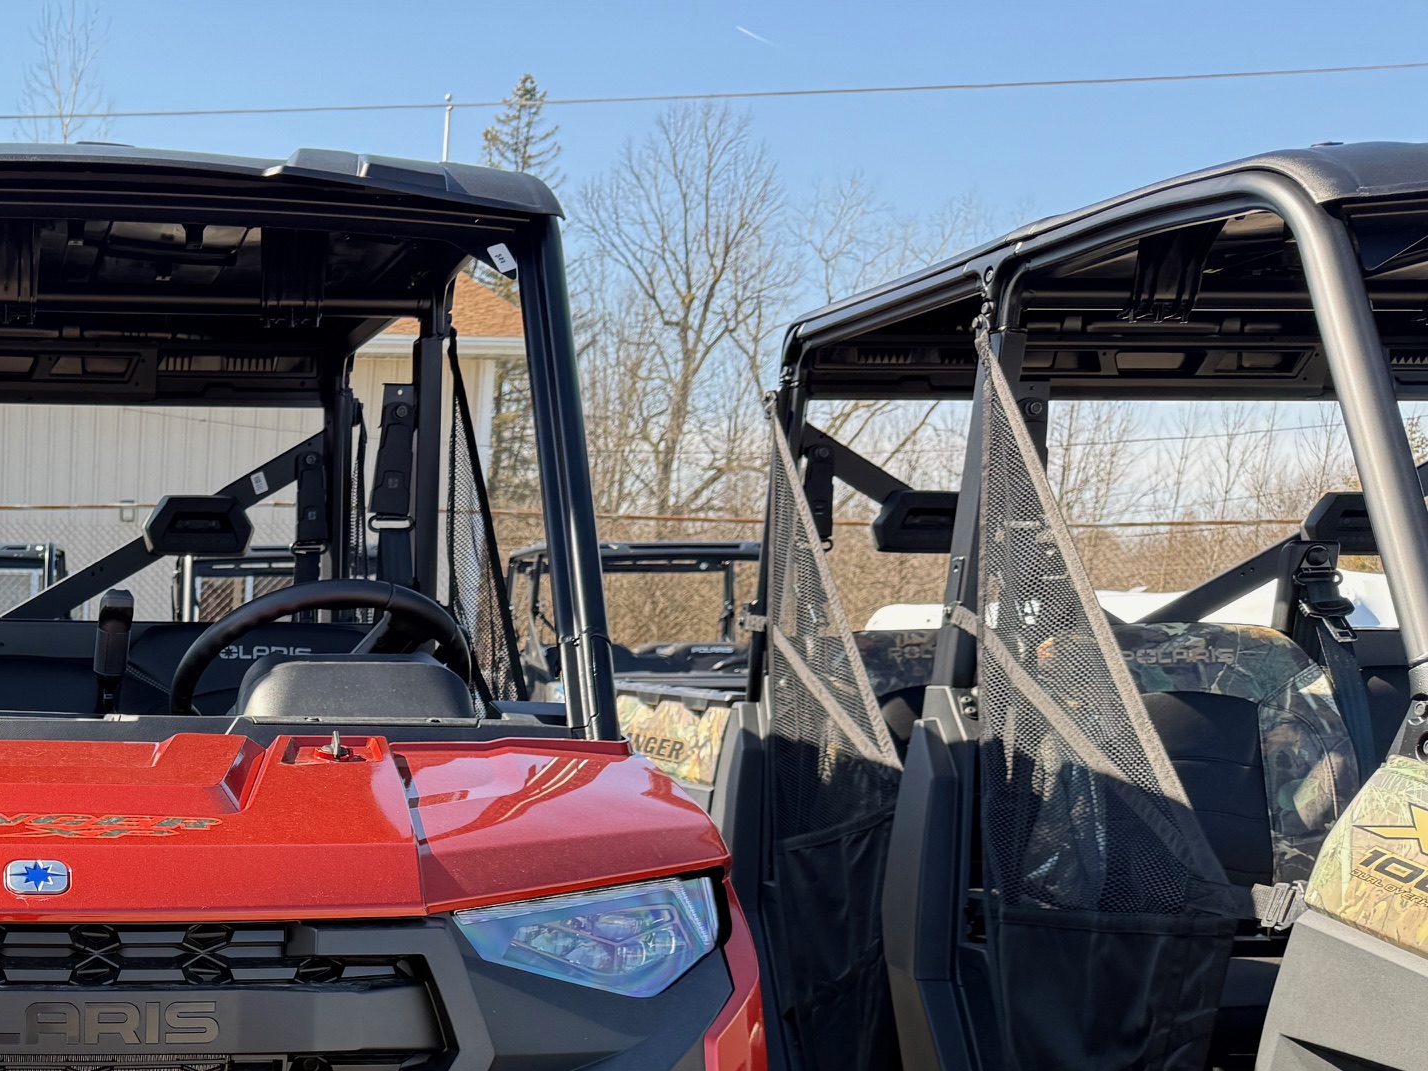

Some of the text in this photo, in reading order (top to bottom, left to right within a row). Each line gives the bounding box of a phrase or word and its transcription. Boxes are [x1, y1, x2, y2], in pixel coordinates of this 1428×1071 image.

[219, 645, 312, 660] OLARIS
[1121, 648, 1235, 665] POLARIS
[628, 733, 685, 761] NGER
[1350, 868, 1383, 887] DUAL
[1357, 847, 1428, 894] 10
